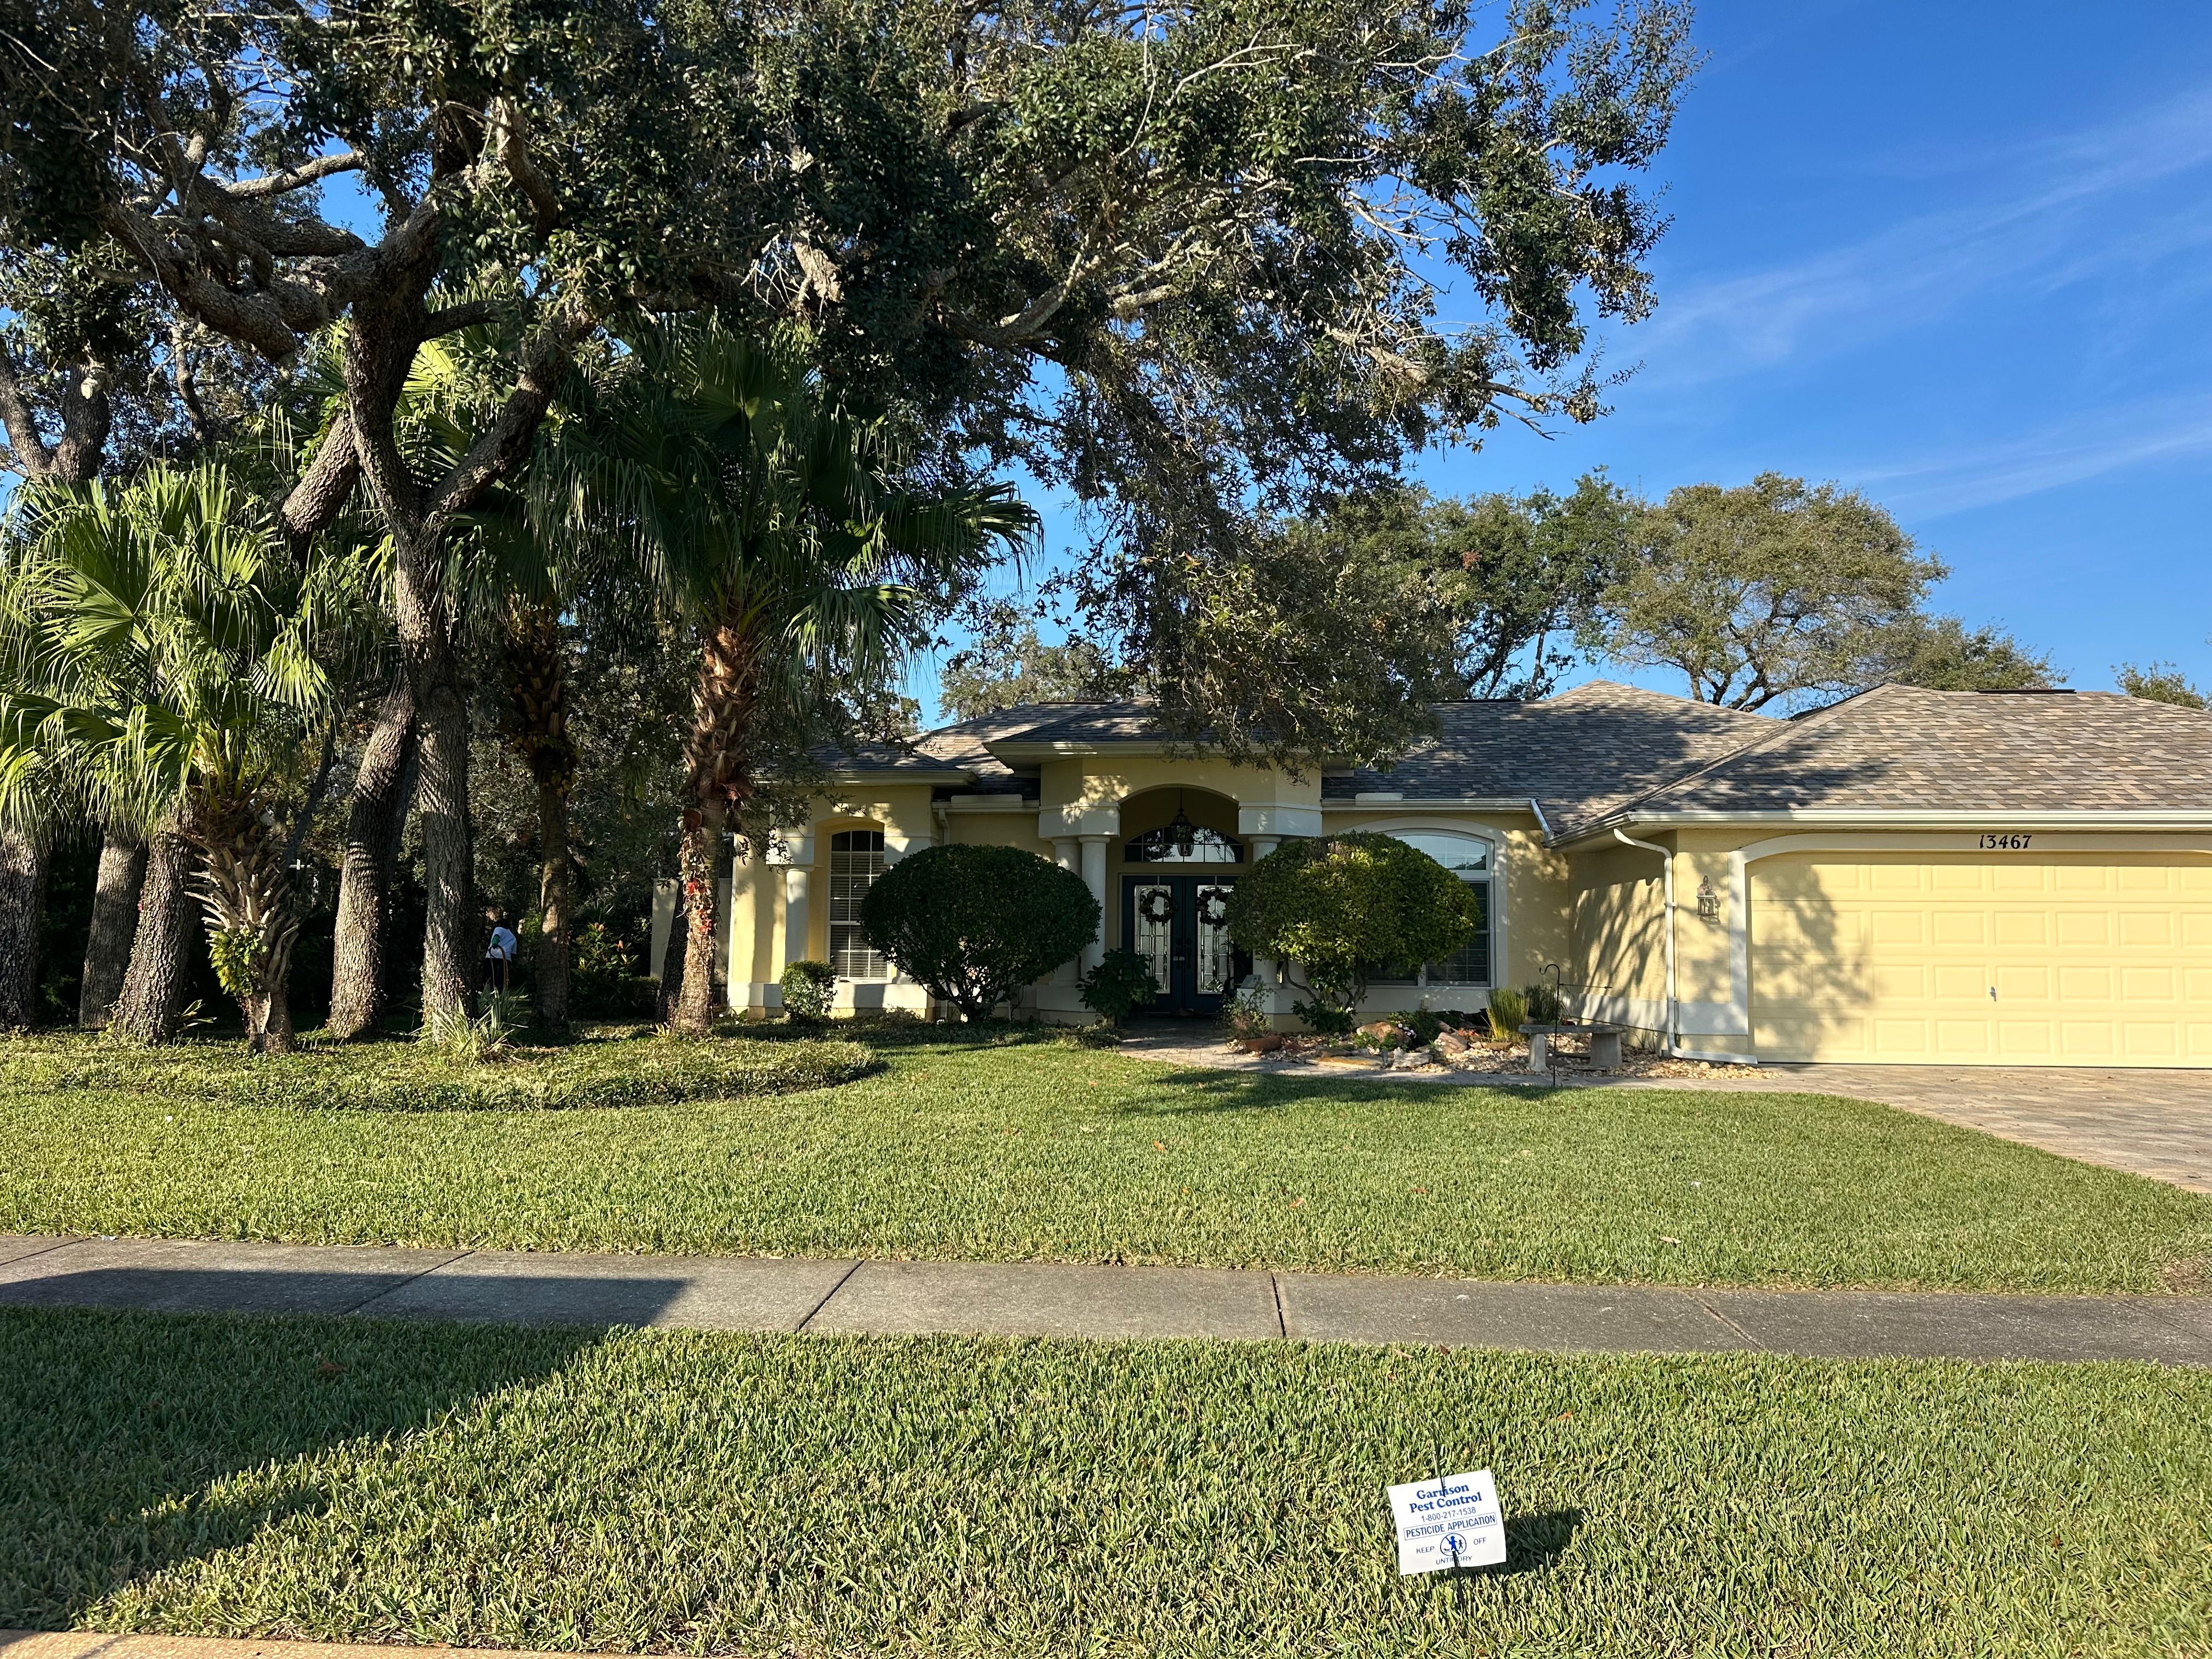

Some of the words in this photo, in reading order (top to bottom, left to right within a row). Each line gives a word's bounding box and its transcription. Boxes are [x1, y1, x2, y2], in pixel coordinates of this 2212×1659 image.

[1979, 834, 2033, 849] 13467
[1409, 1501, 1435, 1513] Pest
[1437, 1492, 1482, 1508] Control
[1421, 1506, 1476, 1522] 1-800-217-1538
[1406, 1524, 1445, 1538] PESTICIDE
[1447, 1514, 1496, 1531] APPLICATION
[1416, 1546, 1435, 1554] KEEP
